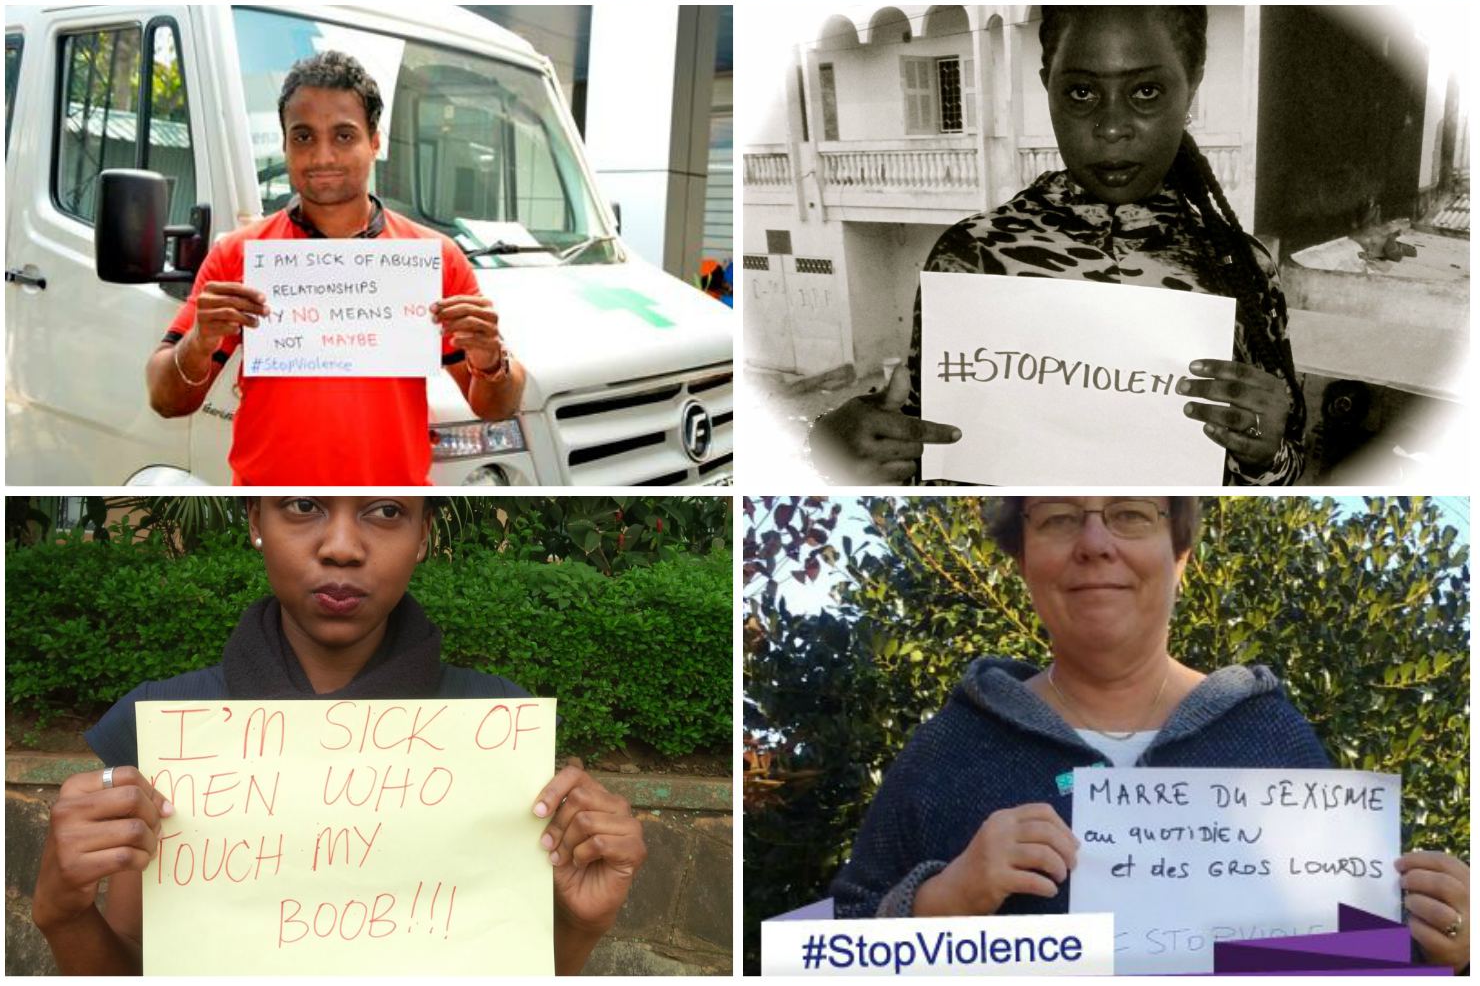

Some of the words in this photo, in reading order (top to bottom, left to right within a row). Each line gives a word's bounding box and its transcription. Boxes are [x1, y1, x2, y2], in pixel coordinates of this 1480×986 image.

[254, 255, 264, 268] I
[275, 255, 299, 267] AM
[307, 255, 343, 266] SICK
[354, 255, 373, 266] OF
[380, 255, 441, 269] ABUSIVE
[273, 282, 377, 296] RELATIONSHIPS
[292, 307, 320, 323] NO
[330, 307, 392, 321] MEANS
[404, 304, 427, 317] NO
[275, 337, 303, 349] NOT
[322, 334, 378, 347] MAYBE
[251, 357, 353, 371] #StopViolence
[158, 707, 285, 760] I'M
[319, 701, 448, 754] SICK
[475, 703, 540, 751] OF
[151, 769, 280, 817] MEN
[323, 765, 453, 812] WHO
[1089, 778, 1189, 806] MARRE
[1084, 829, 1116, 844] au
[157, 831, 283, 886] TOUCH
[313, 822, 382, 872] MY
[1111, 854, 1136, 877] et
[1151, 859, 1189, 878] des
[1209, 860, 1271, 876] GROS
[1290, 857, 1383, 878] LOURDS
[278, 881, 457, 949] BOOB!!!
